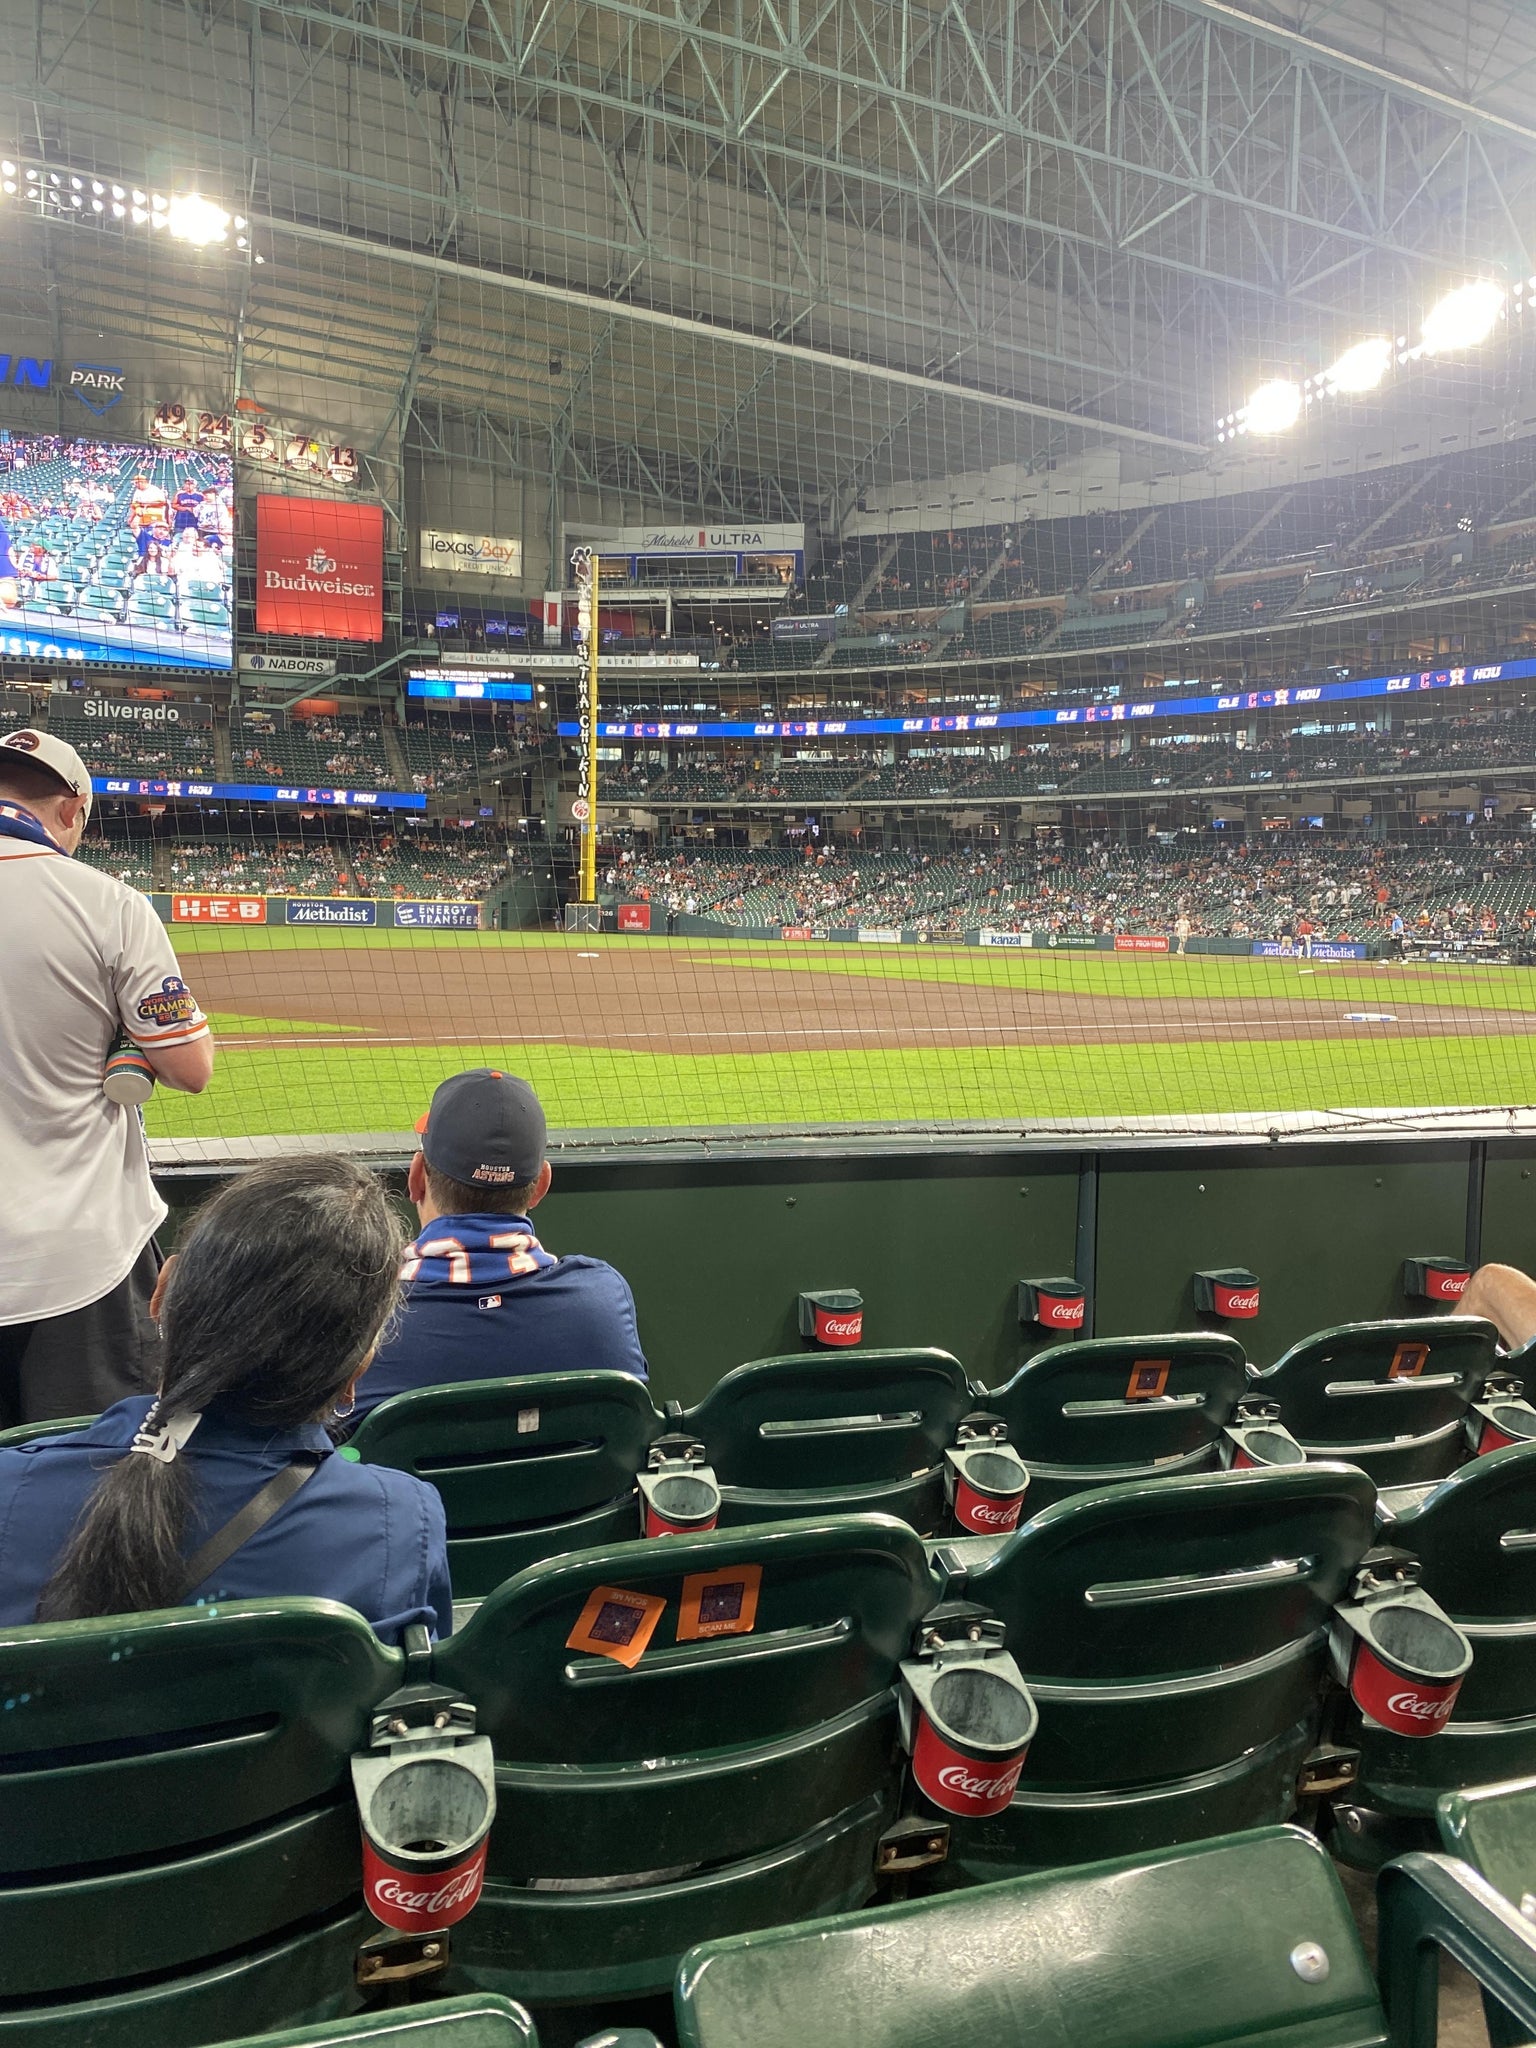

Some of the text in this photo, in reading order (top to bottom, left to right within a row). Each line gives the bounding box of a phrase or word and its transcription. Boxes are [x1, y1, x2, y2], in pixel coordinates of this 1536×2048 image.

[70, 371, 126, 391] PARK
[155, 402, 186, 424] 49
[199, 412, 230, 436] 24
[252, 424, 266, 445] 5
[295, 436, 310, 456] 7
[331, 446, 357, 467] 13
[642, 533, 763, 548] Michelob ULTRA
[428, 534, 515, 565] Texas Bay
[458, 561, 512, 573] CREDIT UNION
[268, 658, 325, 673] NABORS
[1387, 677, 1411, 691] CLE
[1473, 666, 1501, 680] HOU
[1217, 696, 1239, 708] CLE
[1296, 688, 1321, 700] HOU
[83, 700, 179, 722] Silverado
[1056, 710, 1078, 721] CLE
[1131, 704, 1154, 716] HOU
[605, 725, 626, 735] CLE
[676, 725, 697, 735] HOU
[754, 724, 774, 735] CLE
[824, 723, 846, 733] HOU
[903, 719, 923, 730] CLE
[974, 716, 997, 727] HOU
[577, 714, 591, 798] CHIKIN
[106, 781, 130, 792] CLE
[188, 785, 212, 795] HOU
[277, 790, 299, 799] CLE
[354, 793, 377, 803] HOU
[179, 900, 260, 918] H-E-B
[293, 906, 369, 922] Methodist
[419, 905, 467, 915] ENERGY
[419, 915, 480, 925] TRANSFER
[1312, 947, 1356, 958] Methodist
[471, 1168, 515, 1182] ASTROS
[480, 1163, 511, 1172] HOUSTON
[611, 1592, 649, 1606] SCAN ME
[698, 1622, 737, 1634] SCAN ME
